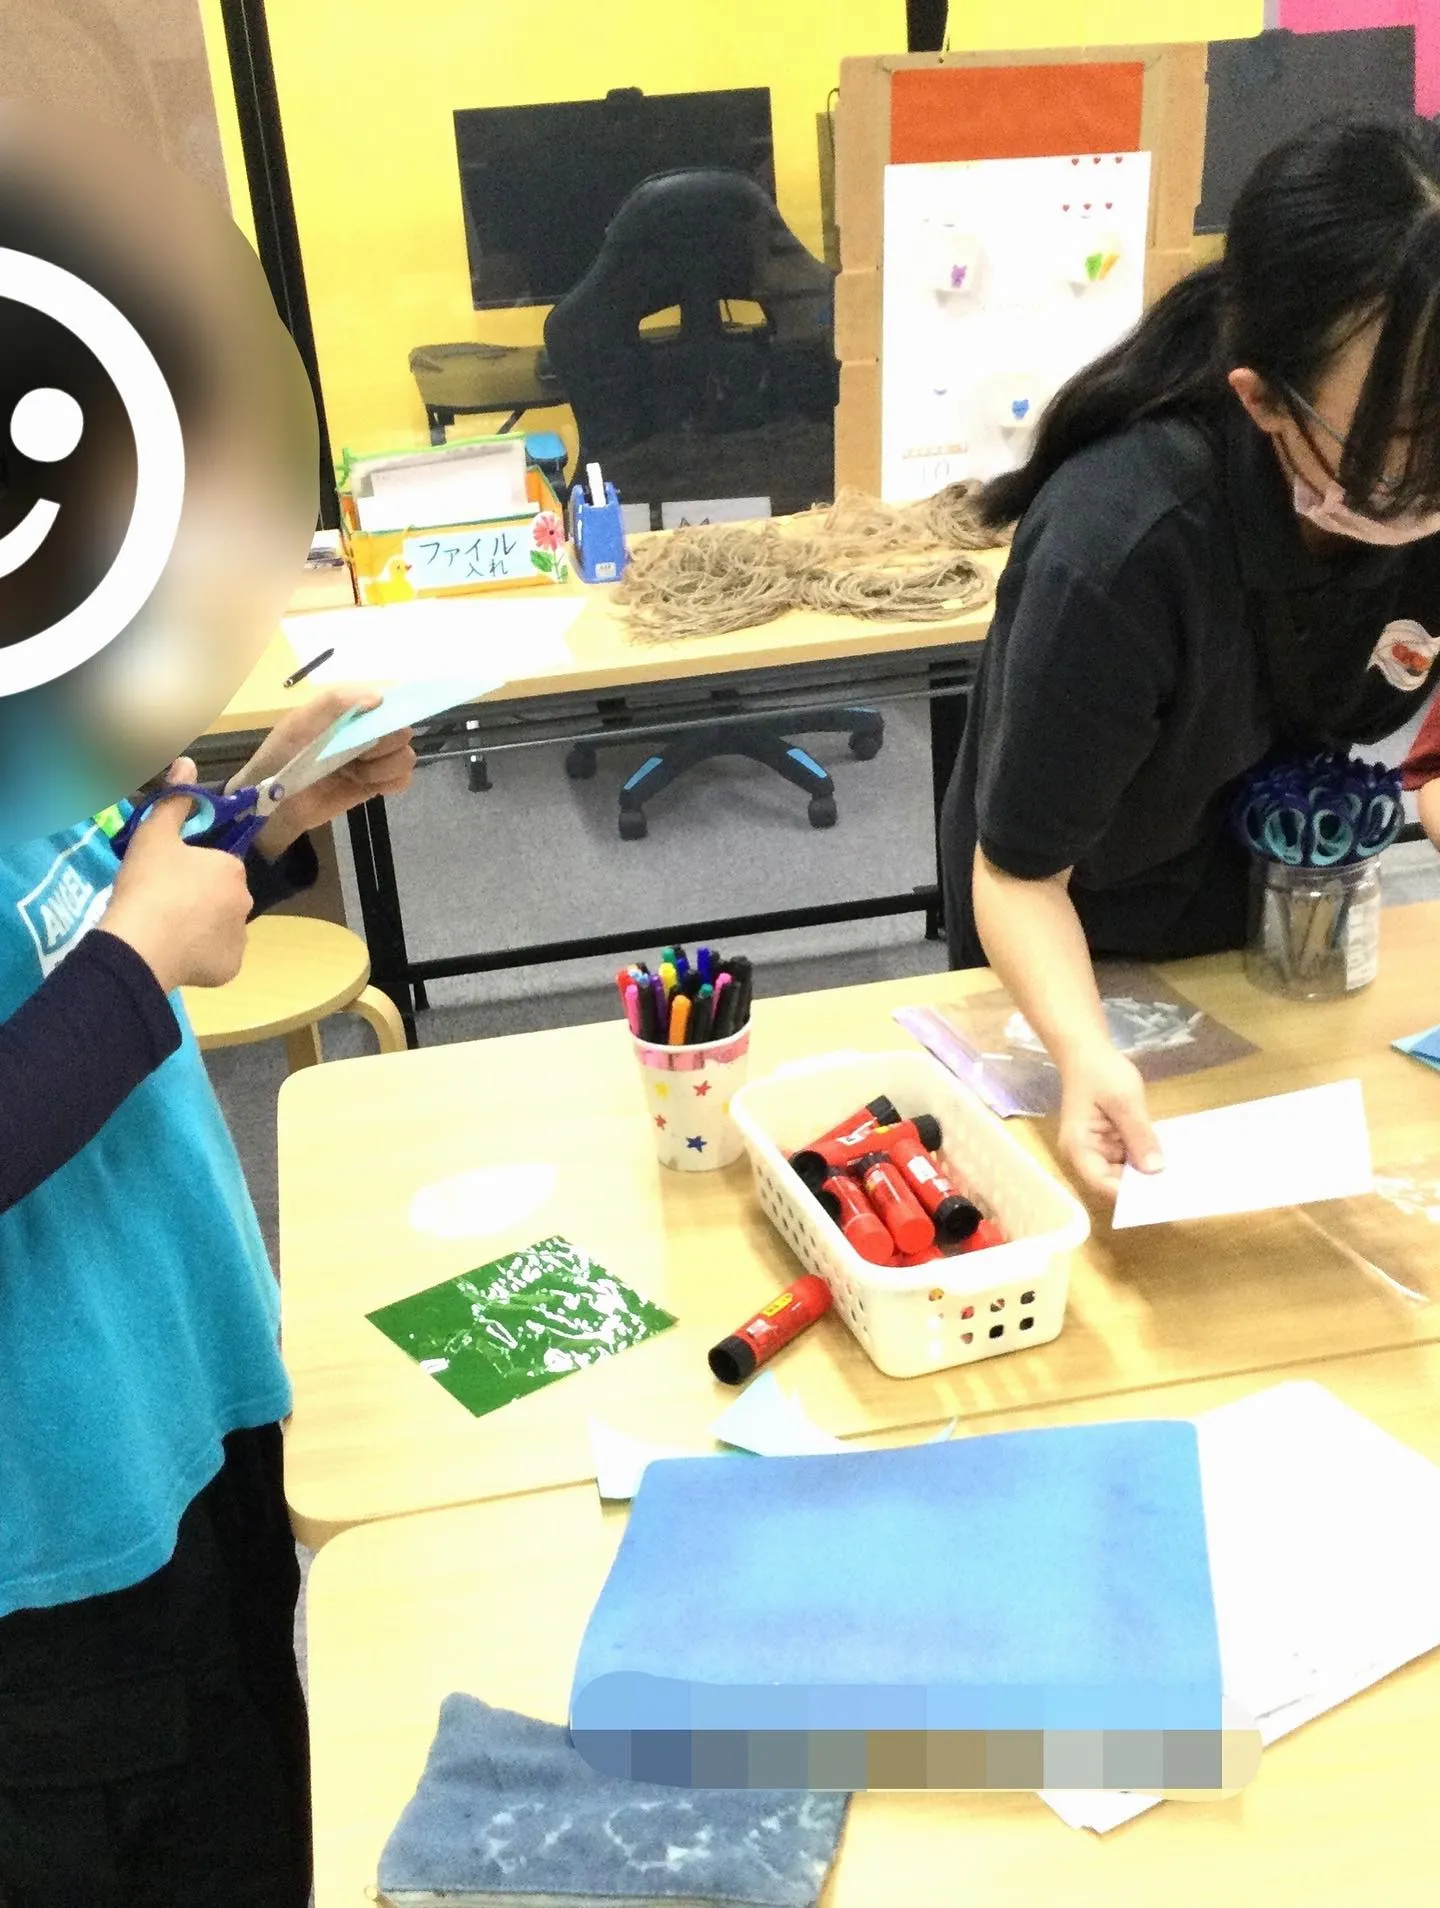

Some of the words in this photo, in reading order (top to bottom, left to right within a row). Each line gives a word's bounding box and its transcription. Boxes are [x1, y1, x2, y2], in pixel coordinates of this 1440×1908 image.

[418, 532, 517, 567] ファイル
[466, 558, 508, 577] 入れ
